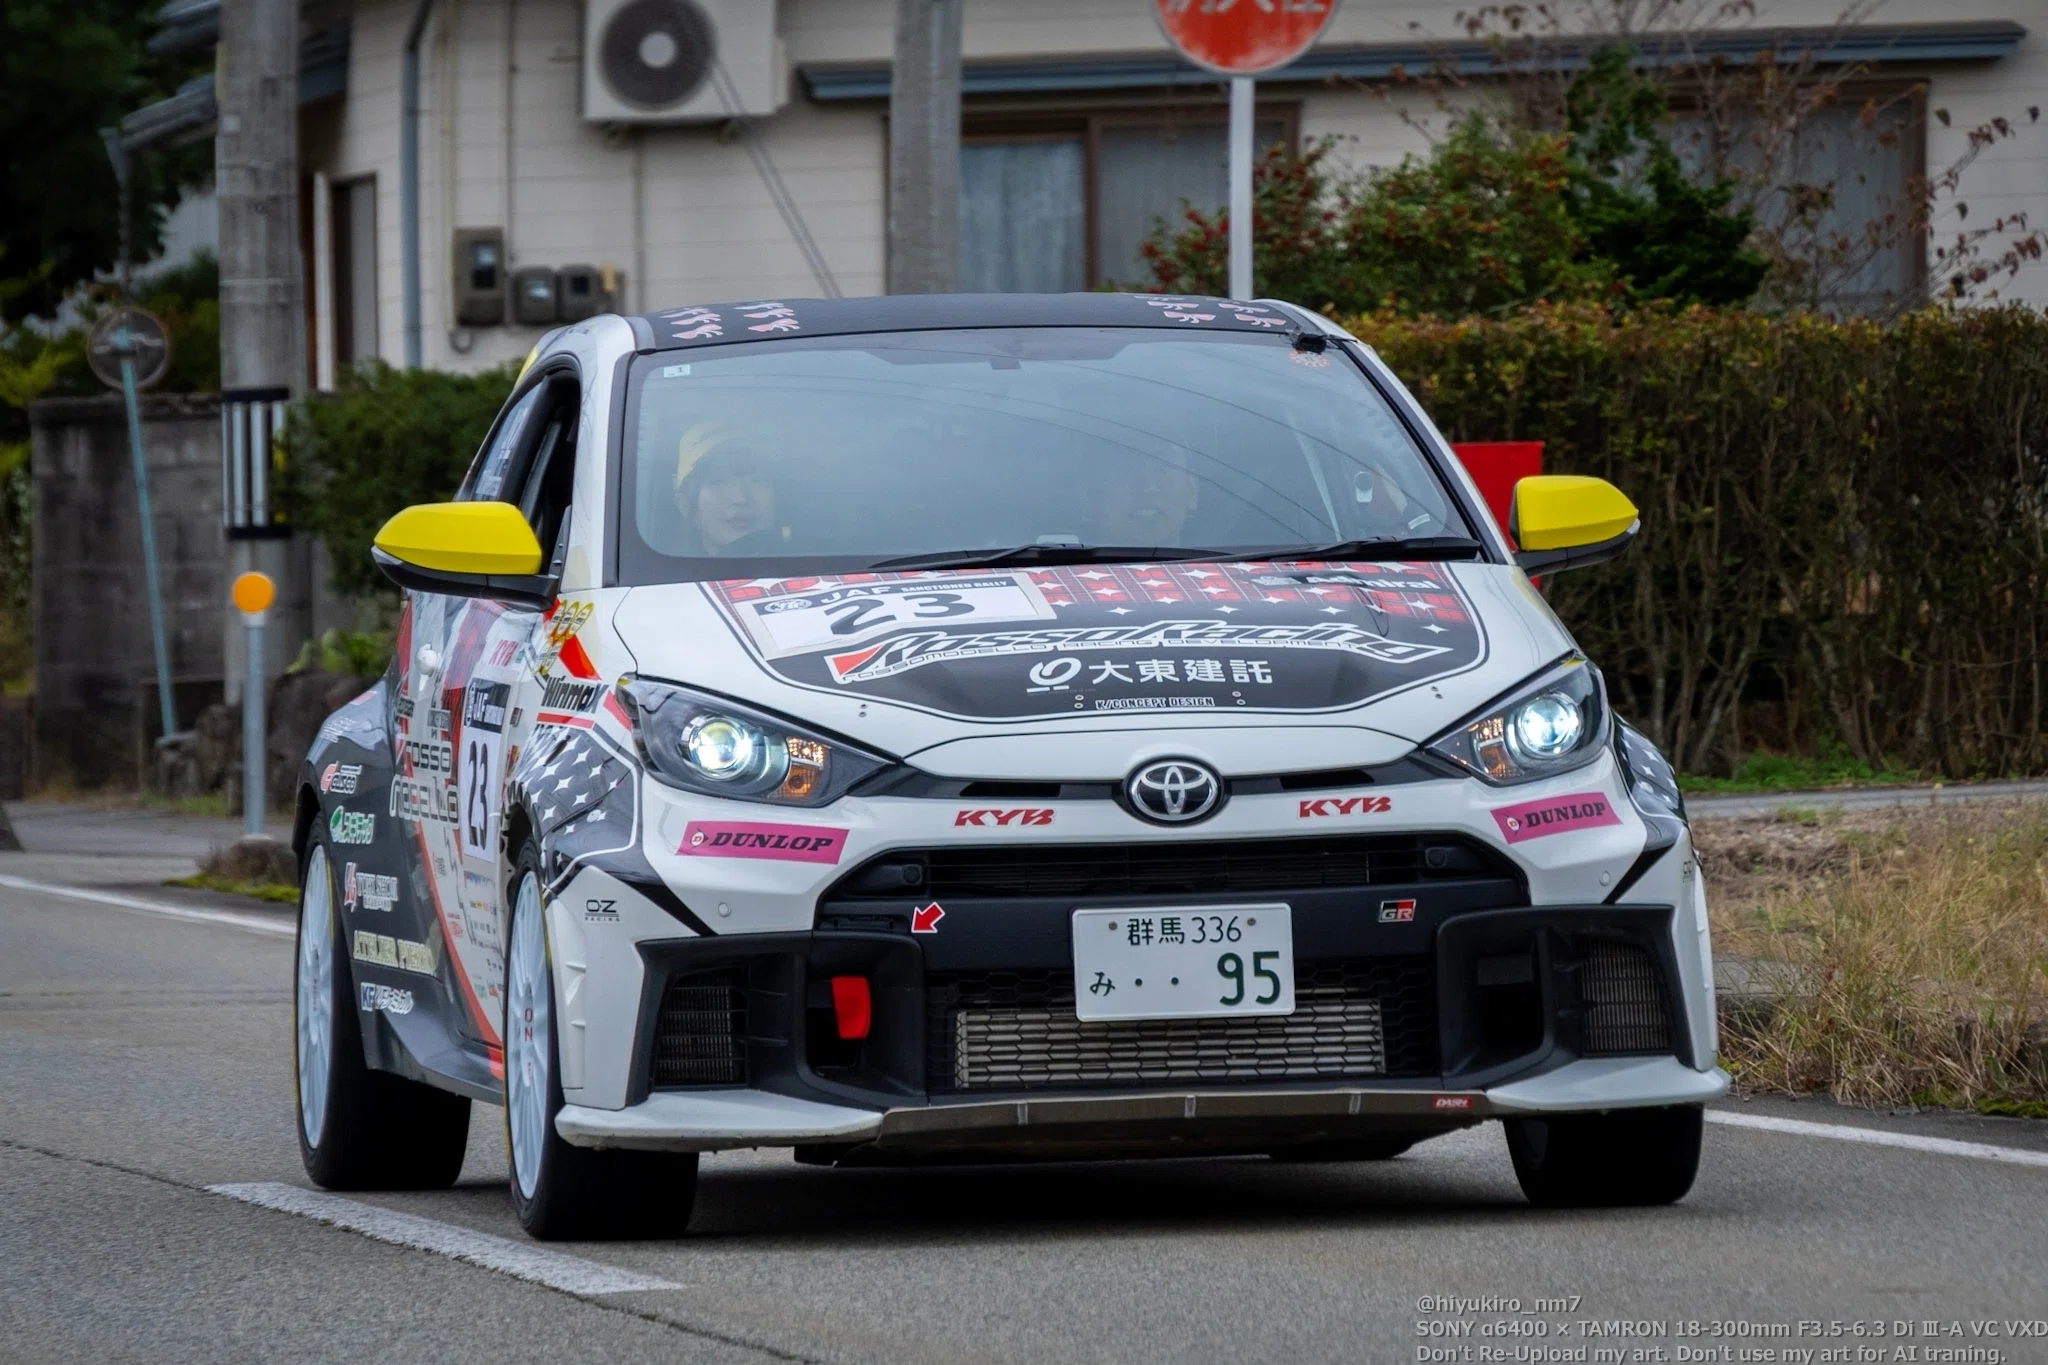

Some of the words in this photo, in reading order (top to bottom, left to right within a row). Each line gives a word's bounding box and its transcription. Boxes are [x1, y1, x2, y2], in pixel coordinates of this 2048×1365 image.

[820, 586, 891, 603] JAF
[900, 583, 972, 592] SANCTIONED
[974, 580, 1007, 588] RALLY
[824, 593, 975, 635] 23
[1089, 658, 1272, 685] 大東建託
[1095, 697, 1166, 710] K/CONCEPT
[1168, 696, 1215, 707] DESIGN
[468, 740, 488, 851] 23
[1299, 796, 1392, 818] KYB
[954, 808, 1054, 826] KYB
[1524, 802, 1605, 828] DUNLOP
[709, 832, 833, 851] DUNLOP
[1381, 908, 1412, 920] GR
[1127, 917, 1185, 945] 群馬
[1191, 916, 1242, 943] 336
[1217, 951, 1281, 1006] 95
